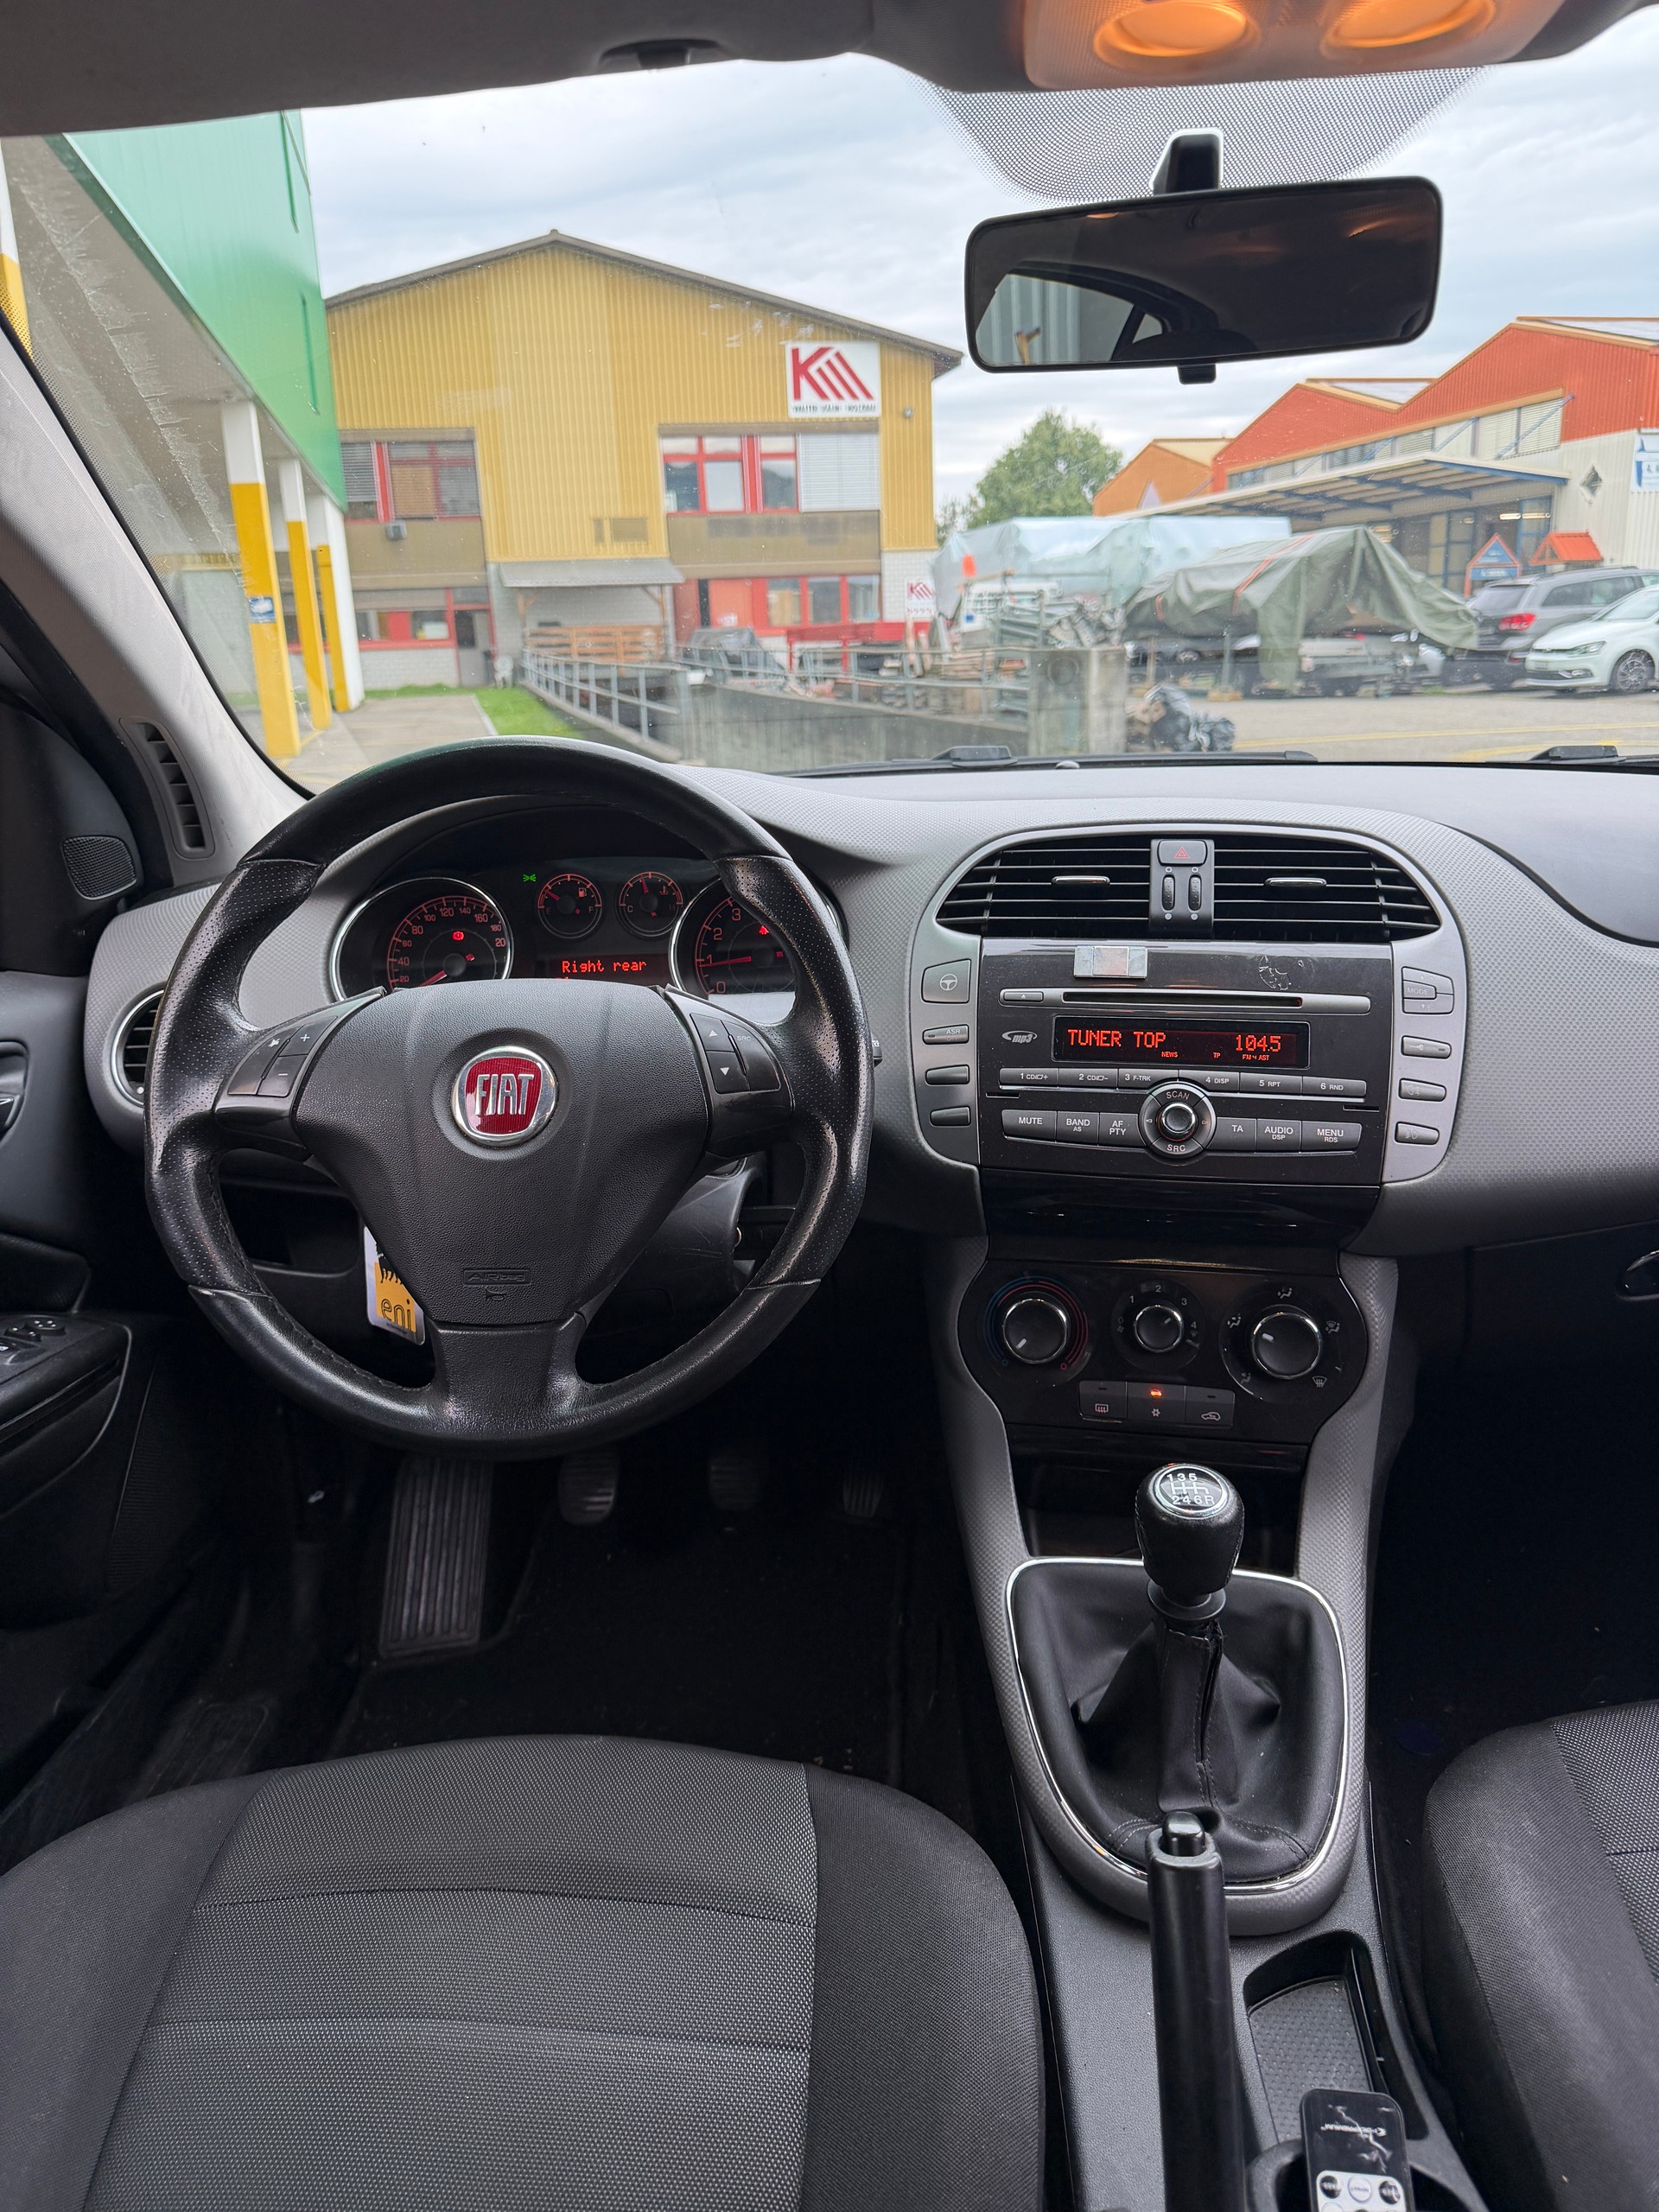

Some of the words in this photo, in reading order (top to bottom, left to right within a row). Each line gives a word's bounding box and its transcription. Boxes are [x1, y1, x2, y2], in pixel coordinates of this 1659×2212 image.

[440, 908, 454, 917] 120
[731, 908, 741, 921] 3
[474, 913, 488, 923] 160
[411, 925, 423, 935] 80
[713, 927, 722, 940] 2
[495, 938, 506, 947] 20
[397, 957, 410, 965] 40
[706, 954, 713, 965] 1
[562, 959, 605, 974] Right
[613, 960, 647, 972] rear
[716, 982, 726, 994] 0
[1407, 987, 1430, 995] MODE
[1011, 1033, 1033, 1044] mp3
[1067, 1029, 1122, 1047] TUNER
[1133, 1031, 1166, 1049] TOP
[1236, 1034, 1281, 1052] 104.5
[475, 1073, 534, 1116] FIAT
[1166, 1090, 1190, 1100] SCAN
[1018, 1116, 1043, 1125] MUTE
[1066, 1118, 1090, 1127] BAND
[1109, 1128, 1127, 1136] PTY
[1231, 1124, 1243, 1133] TA
[1264, 1126, 1294, 1135] AUDIO
[1317, 1128, 1344, 1137] MENU
[1166, 1144, 1185, 1153] SRC
[1155, 1284, 1161, 1293] 2
[1181, 1297, 1187, 1306] 3
[381, 1299, 412, 1331] eni
[1166, 1473, 1173, 1482] 1
[1177, 1472, 1186, 1481] 3
[1189, 1472, 1198, 1481] 5
[1173, 1496, 1181, 1504] 2
[1182, 1496, 1192, 1504] 4
[1193, 1496, 1203, 1504] 6
[1204, 1496, 1214, 1504] R
